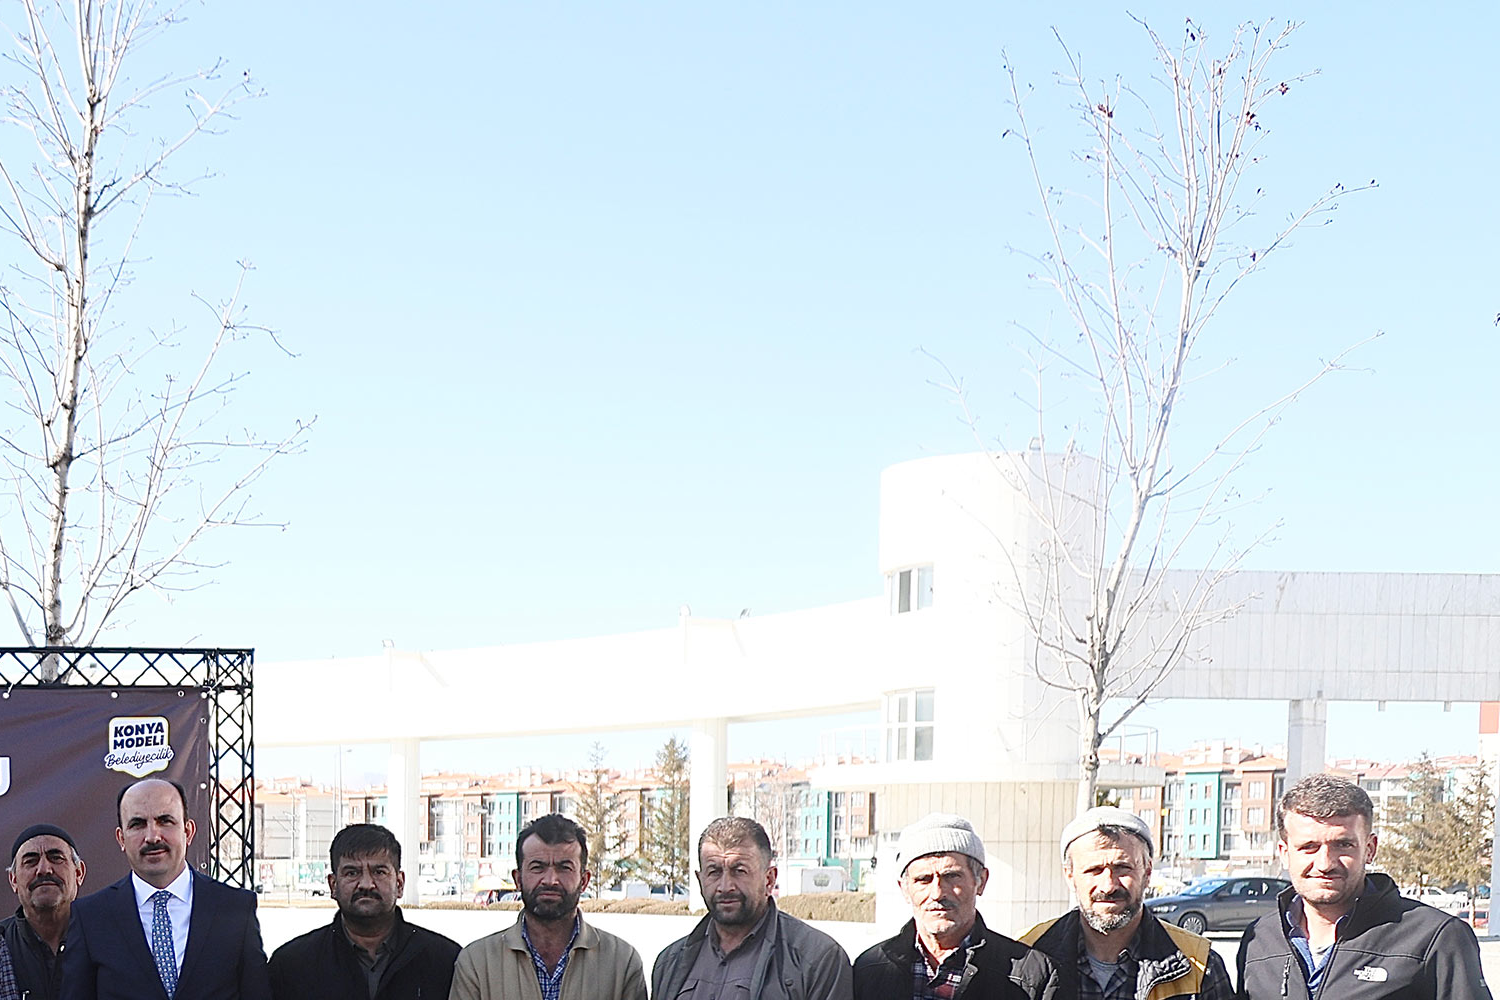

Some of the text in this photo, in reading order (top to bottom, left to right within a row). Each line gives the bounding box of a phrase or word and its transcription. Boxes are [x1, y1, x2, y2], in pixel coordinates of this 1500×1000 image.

[114, 722, 164, 738] KONYA
[113, 735, 164, 749] MODELİ
[105, 747, 173, 769] Belediyecilik
